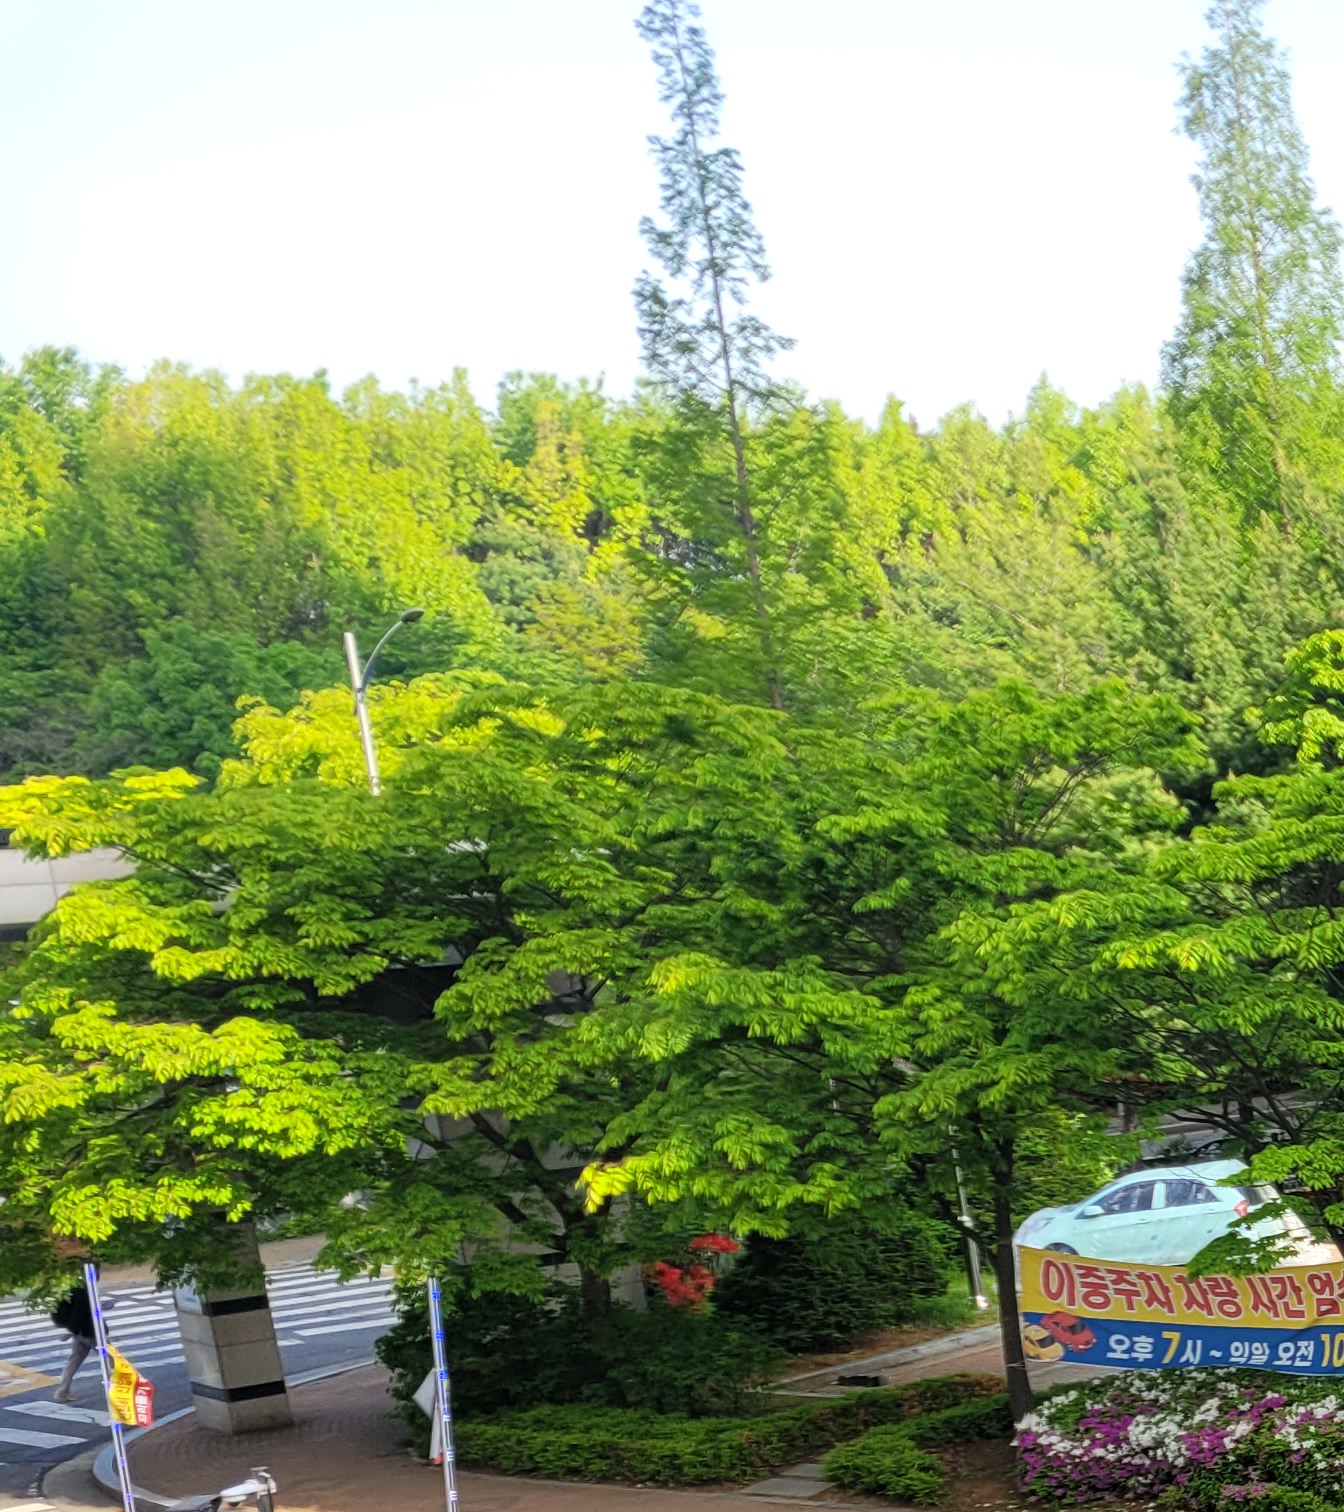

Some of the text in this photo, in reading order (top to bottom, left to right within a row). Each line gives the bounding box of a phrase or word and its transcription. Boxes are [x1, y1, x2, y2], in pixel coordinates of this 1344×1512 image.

[1041, 1257, 1177, 1315] 이중주차
[1172, 1273, 1243, 1320] 차량
[1245, 1273, 1307, 1320] 시간
[1105, 1333, 1155, 1363] 오후
[1229, 1341, 1271, 1366] 익일
[1272, 1340, 1315, 1367] 오전
